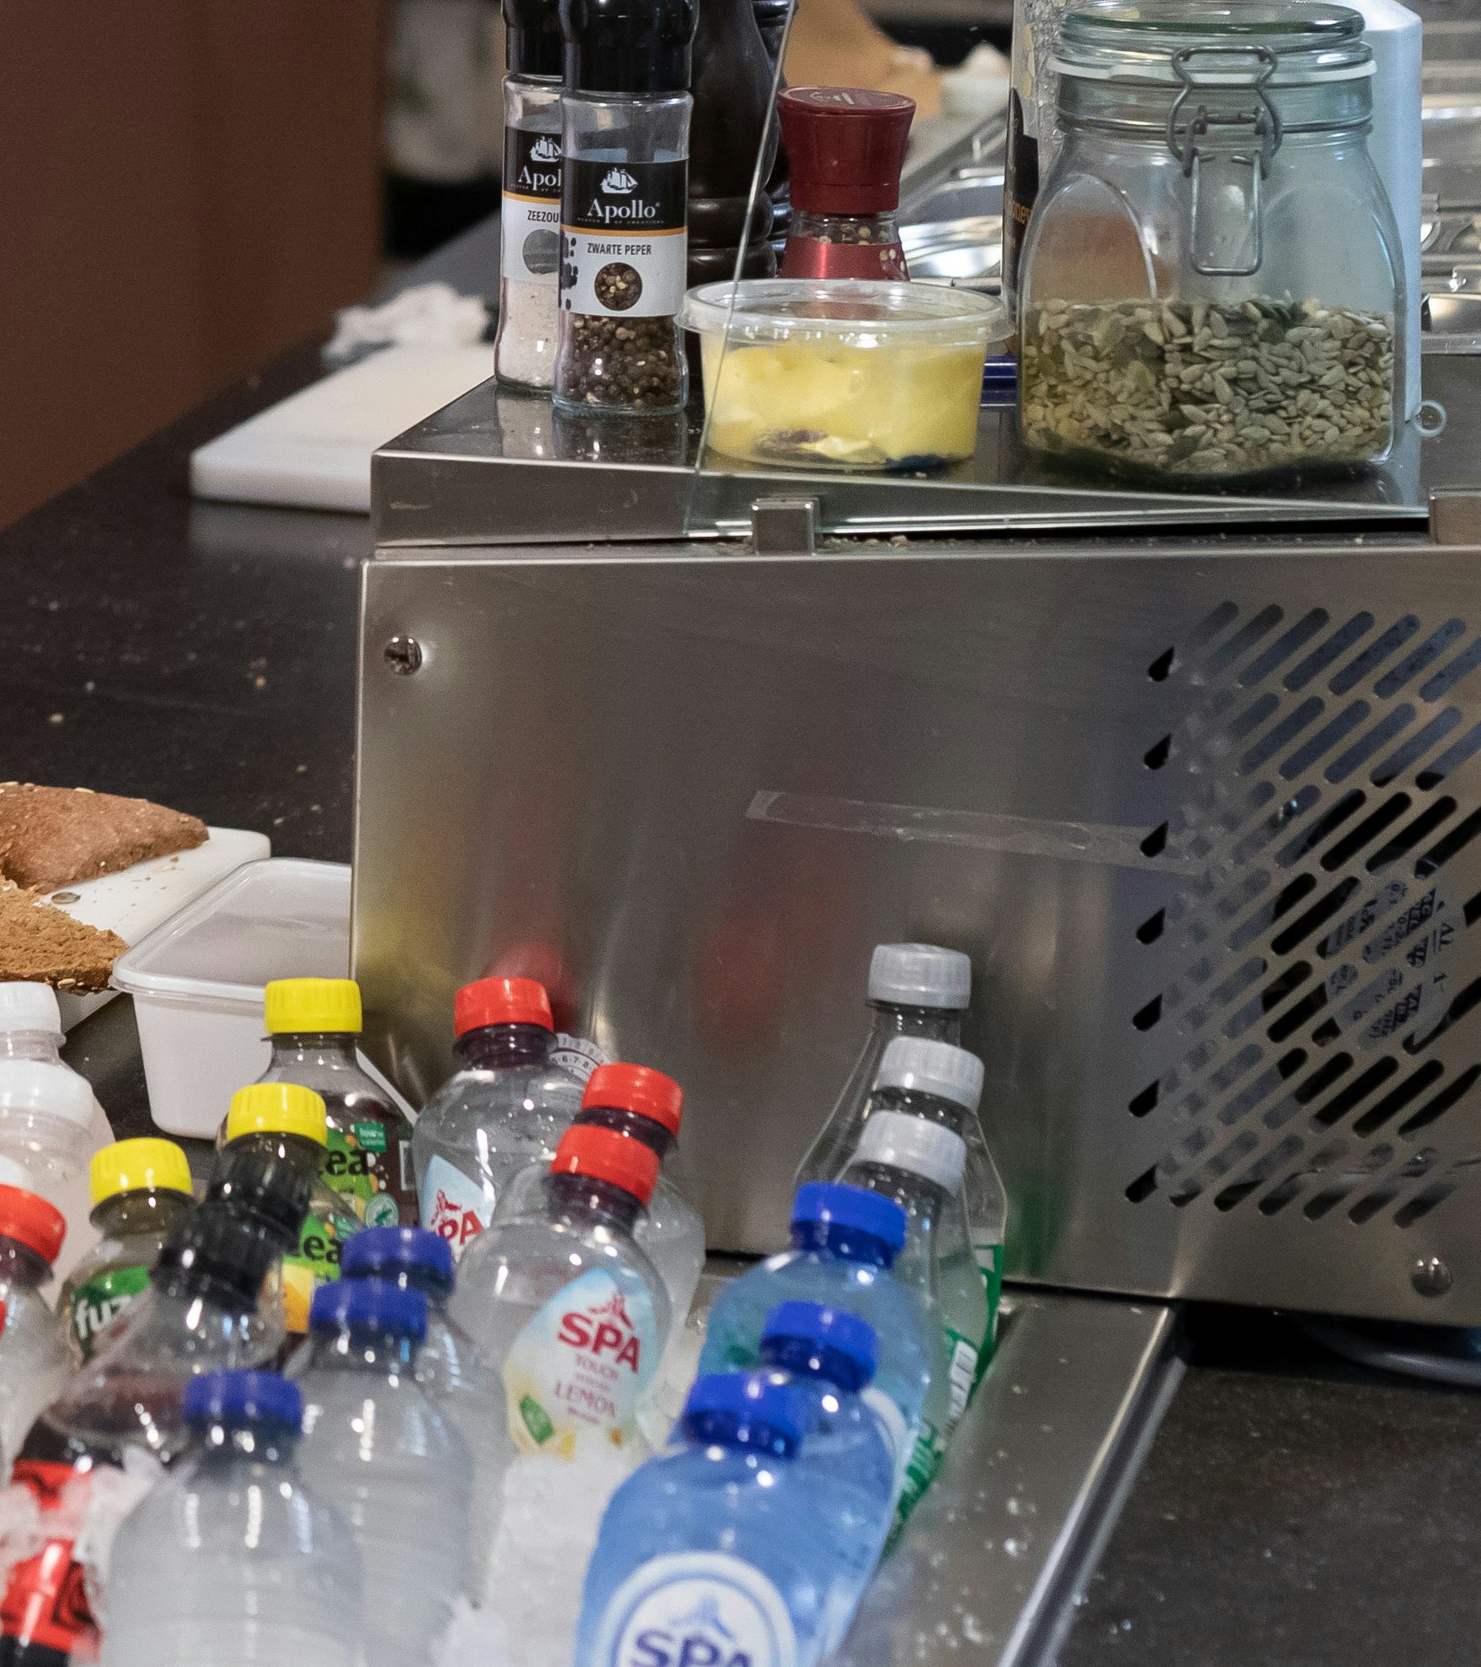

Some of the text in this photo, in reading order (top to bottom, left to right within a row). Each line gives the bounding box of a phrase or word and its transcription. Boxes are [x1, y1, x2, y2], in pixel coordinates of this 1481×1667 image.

[517, 165, 562, 191] Apol
[527, 209, 559, 224] ZEEZOU
[586, 198, 657, 224] Apollo
[586, 242, 652, 256] ZWARTE PEPER
[322, 1148, 369, 1176] ea
[436, 1210, 486, 1246] PA
[303, 1235, 343, 1264] ea
[556, 1310, 642, 1375] SPA
